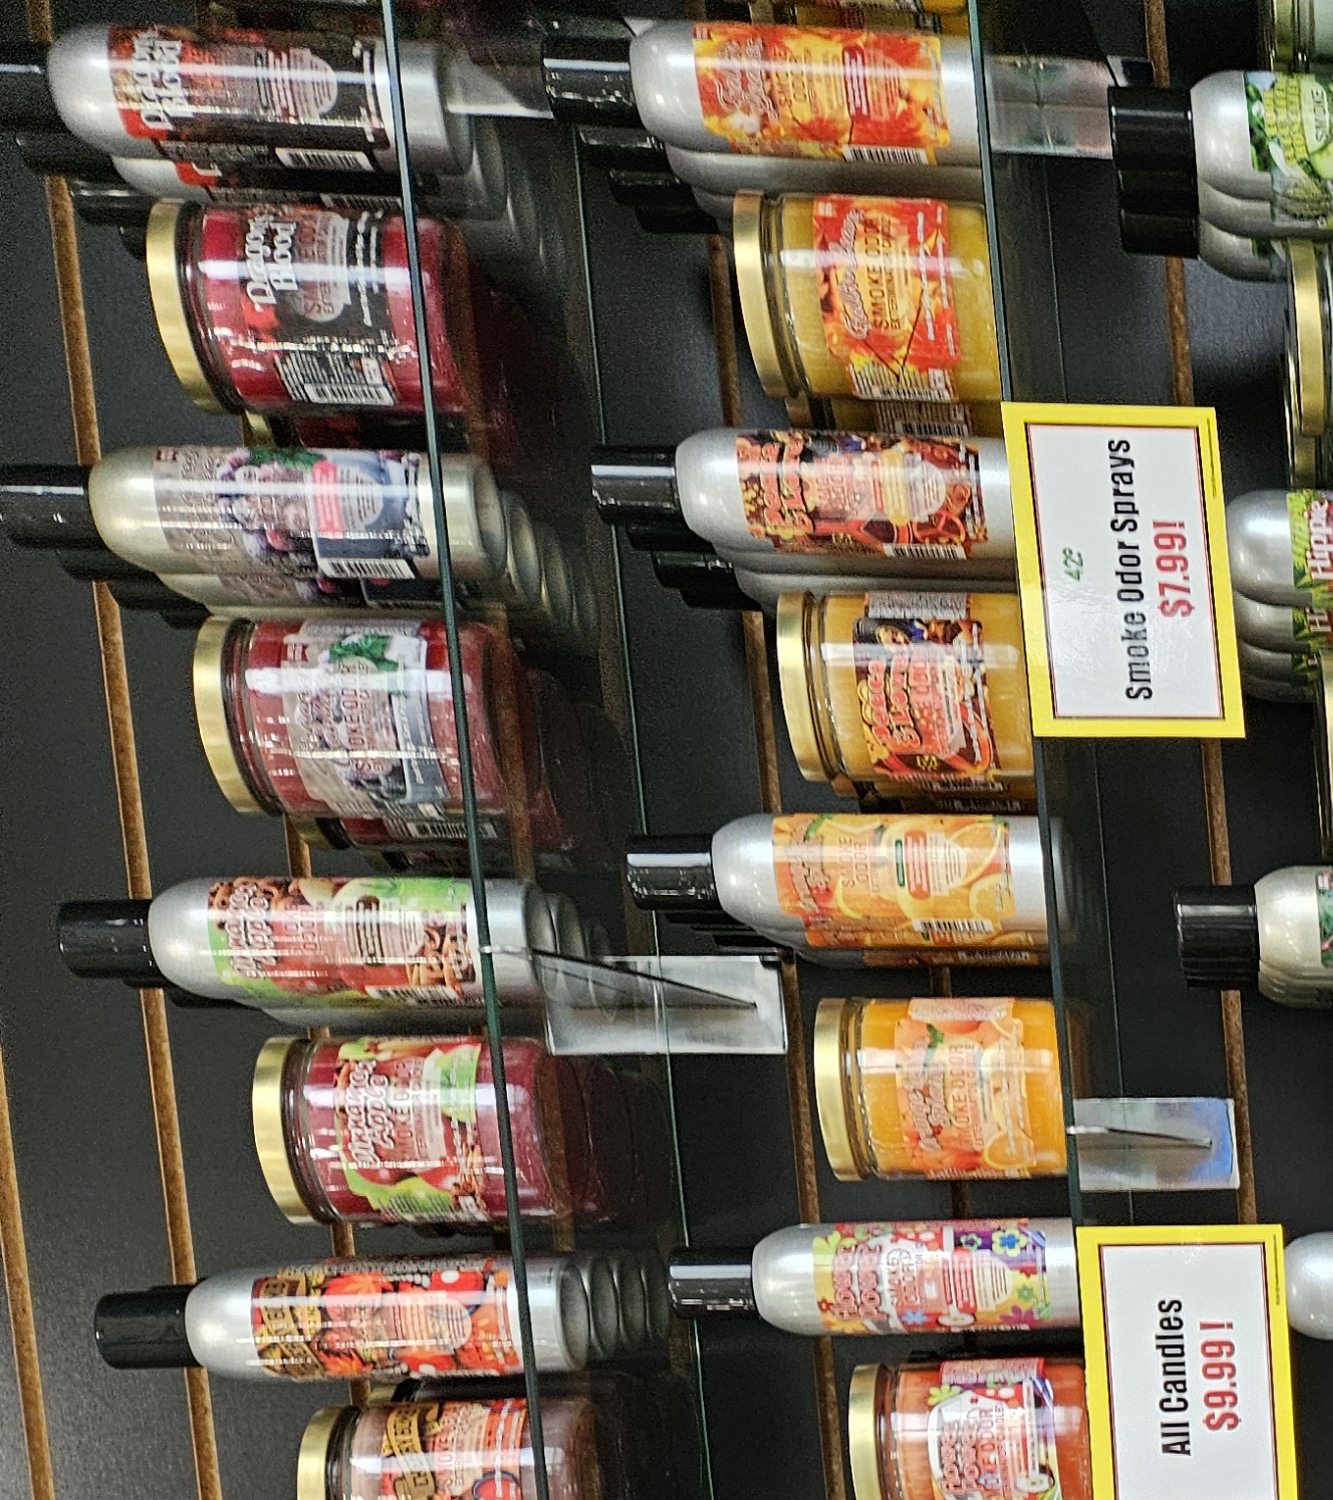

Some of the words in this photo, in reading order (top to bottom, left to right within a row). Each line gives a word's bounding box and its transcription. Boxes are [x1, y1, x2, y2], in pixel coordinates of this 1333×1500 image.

[1107, 439, 1139, 533] Sprays
[1116, 541, 1145, 602] Odor
[1152, 520, 1195, 618] $7.99!
[1120, 612, 1153, 700] Smoke
[1155, 1299, 1189, 1413] Candles
[1200, 1340, 1241, 1431] $9.99
[1161, 1422, 1191, 1456] All
